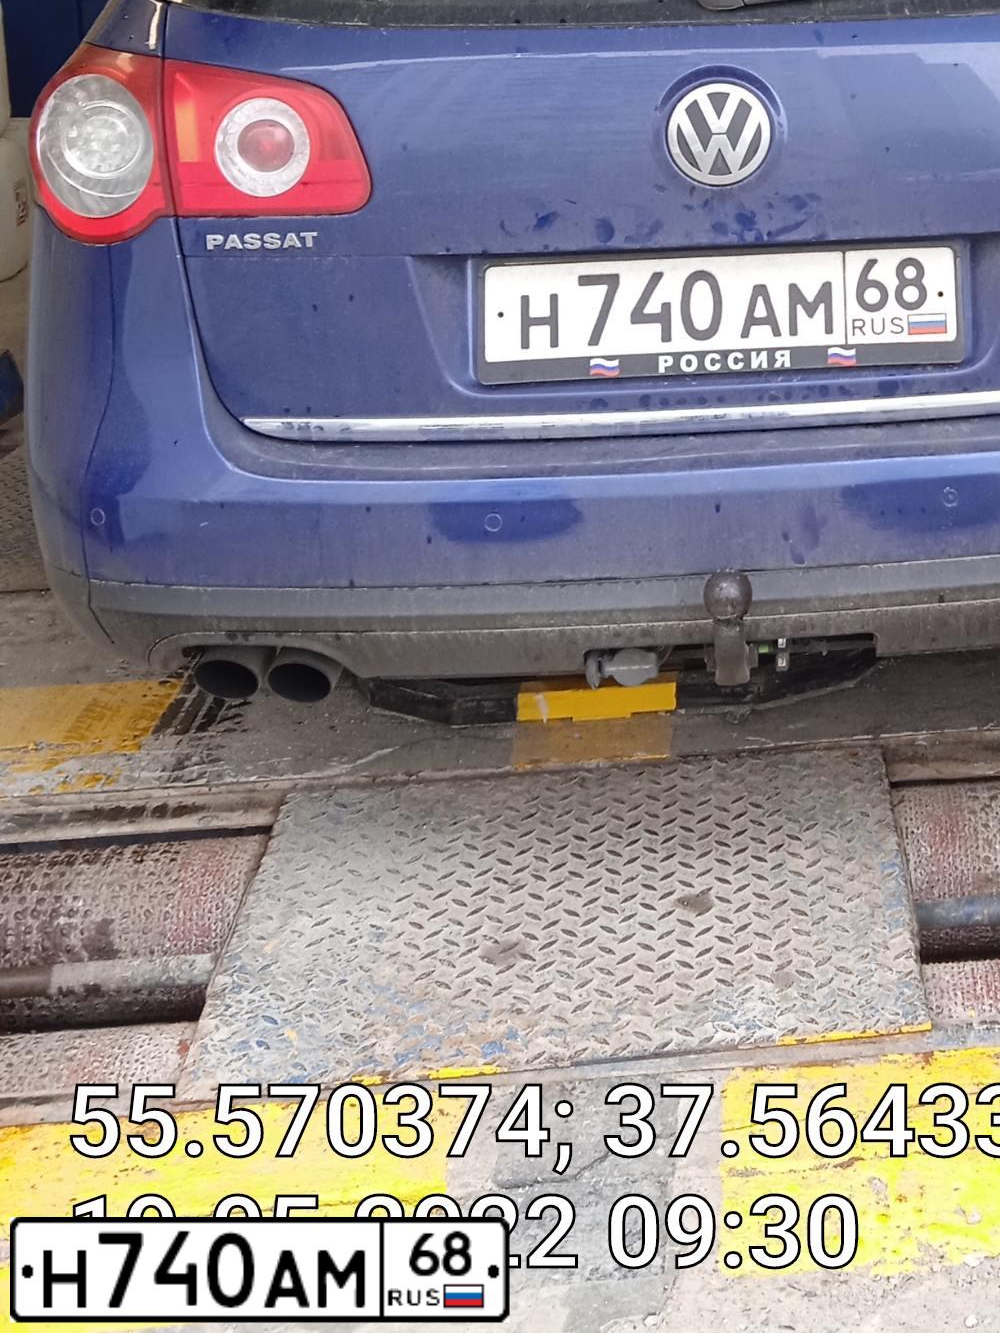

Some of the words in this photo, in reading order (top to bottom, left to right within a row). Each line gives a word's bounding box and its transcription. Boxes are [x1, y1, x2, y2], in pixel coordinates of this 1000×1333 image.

[206, 231, 318, 250] PASSAT
[855, 257, 928, 312] 68
[852, 315, 905, 337] RUS
[658, 349, 792, 373] РОССИЯ
